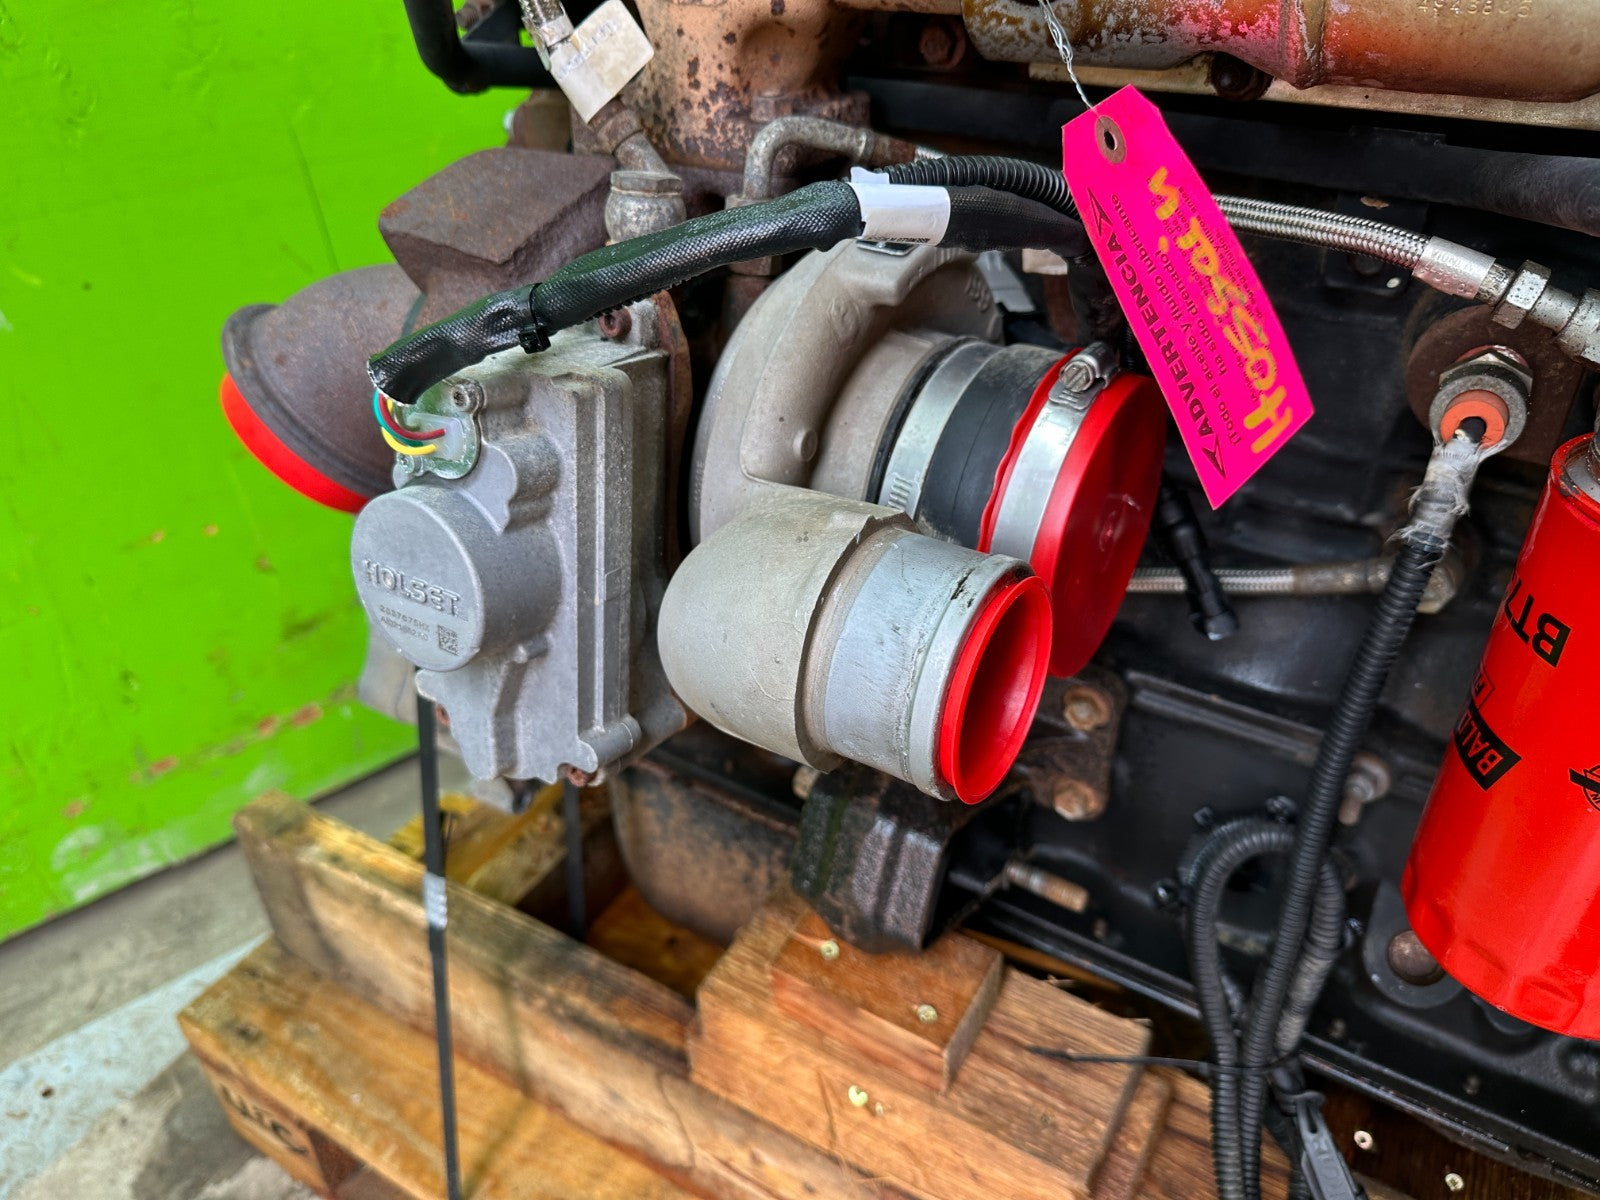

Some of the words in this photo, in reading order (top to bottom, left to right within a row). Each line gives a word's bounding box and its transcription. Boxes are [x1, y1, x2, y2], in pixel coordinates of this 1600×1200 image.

[1110, 193, 1156, 273] lubricante
[1156, 249, 1198, 315] drenado!
[1106, 230, 1214, 436] ADVERTENCIA
[1180, 322, 1191, 333] y
[1200, 318, 1216, 352] sido
[1187, 336, 1213, 381] aceite
[1215, 354, 1226, 376] ha
[1209, 383, 1220, 398] el
[363, 559, 461, 617] HOLSET
